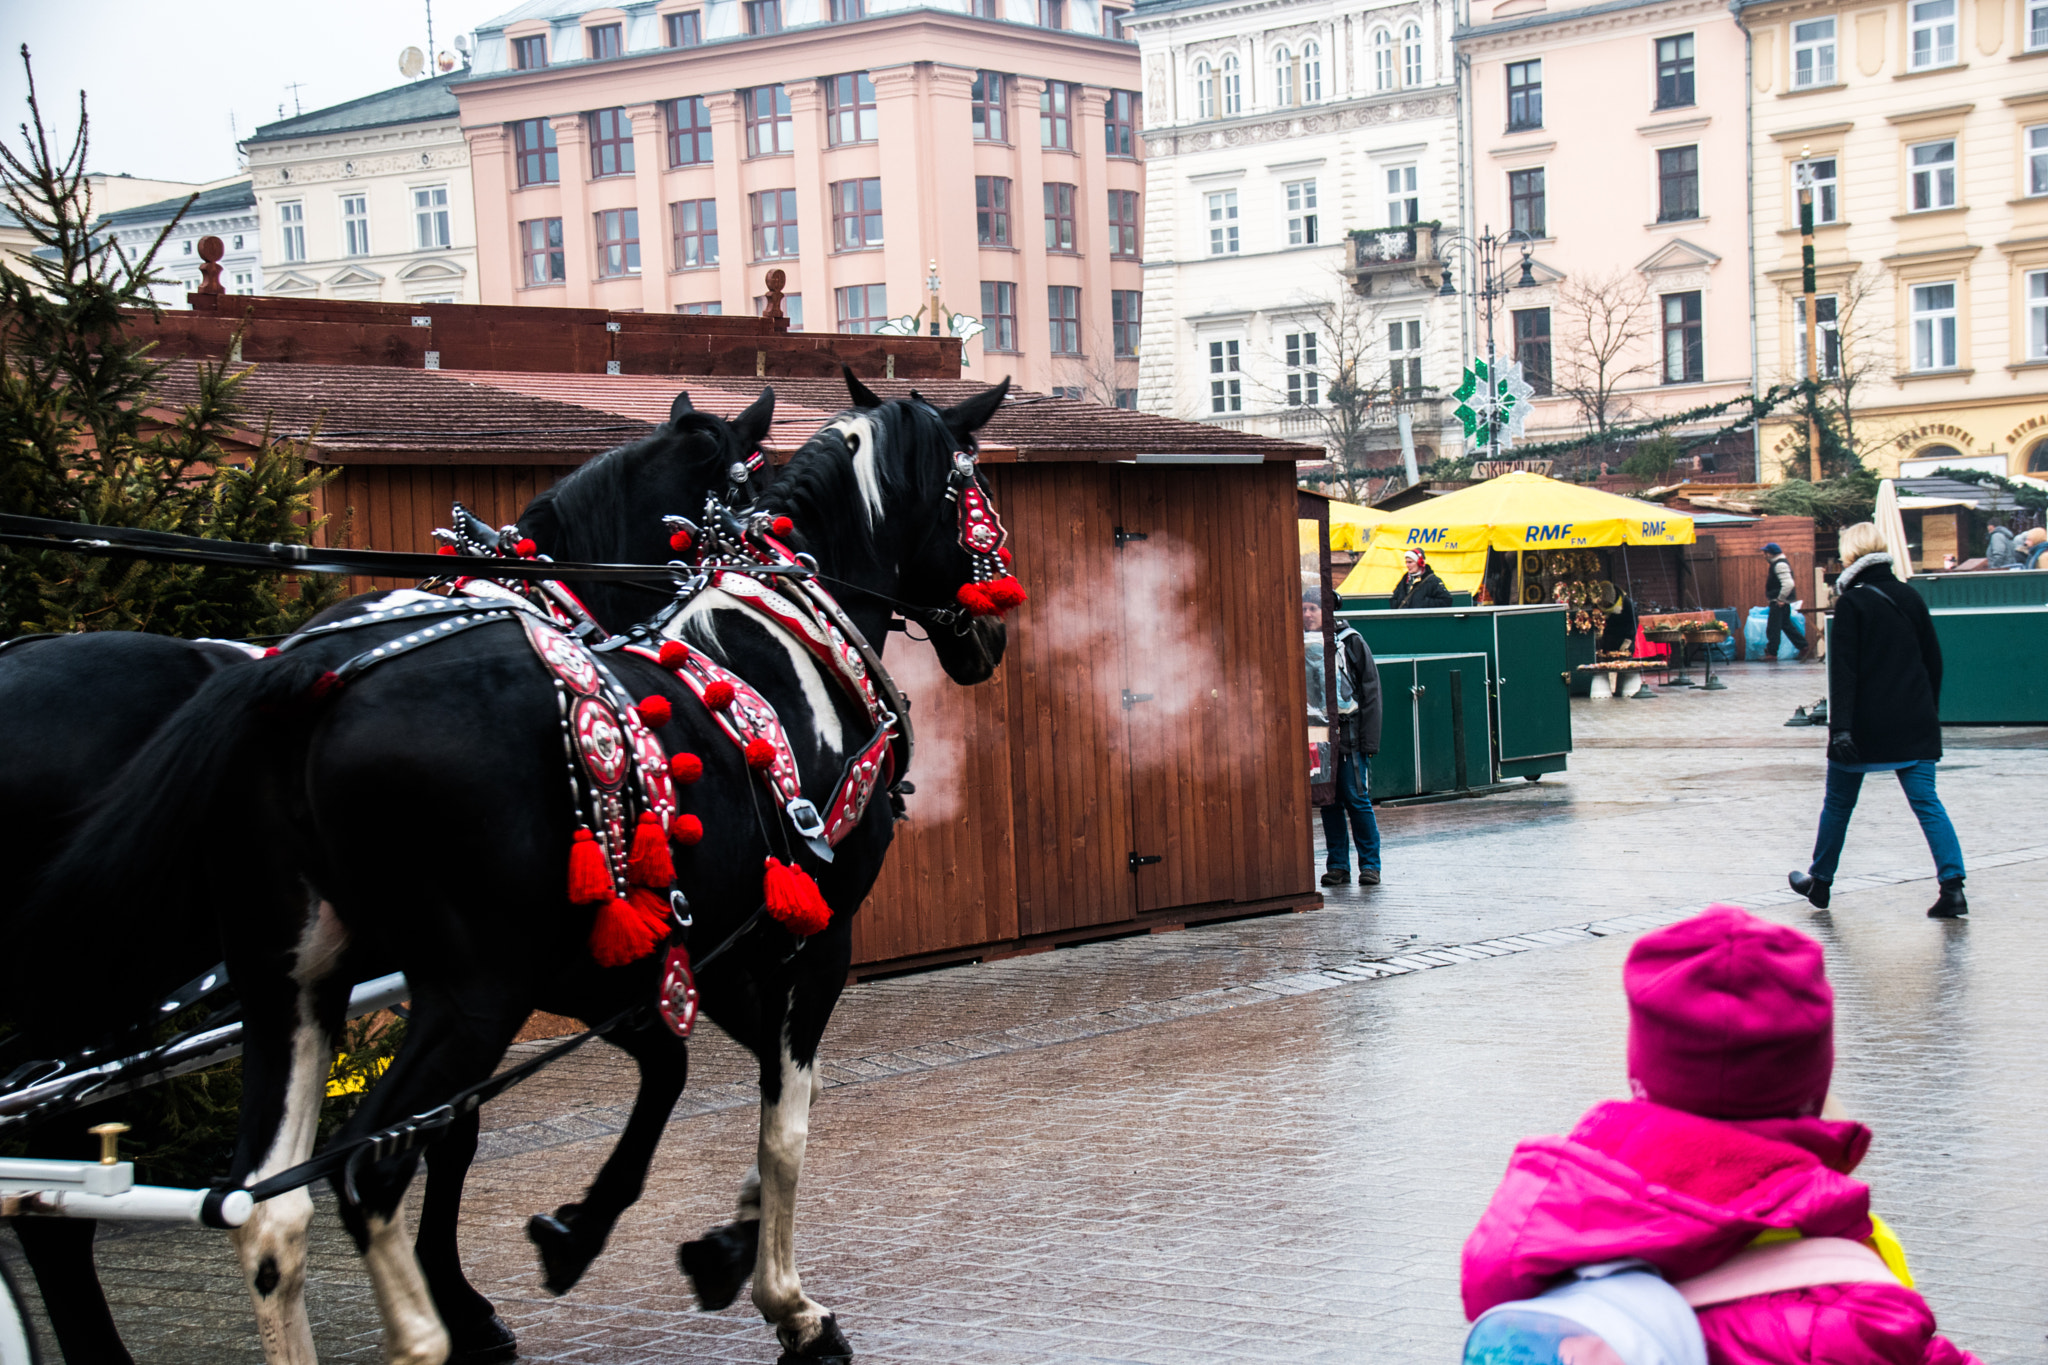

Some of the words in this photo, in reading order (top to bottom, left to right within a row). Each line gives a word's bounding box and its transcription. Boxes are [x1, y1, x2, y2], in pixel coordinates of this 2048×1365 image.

[1896, 423, 1974, 451] APARTHOTEL
[2006, 414, 2048, 445] BETMA
[1406, 528, 1448, 544] RMF
[1525, 523, 1573, 543] RMF
[1571, 537, 1587, 546] FM
[1641, 521, 1666, 538] RMF
